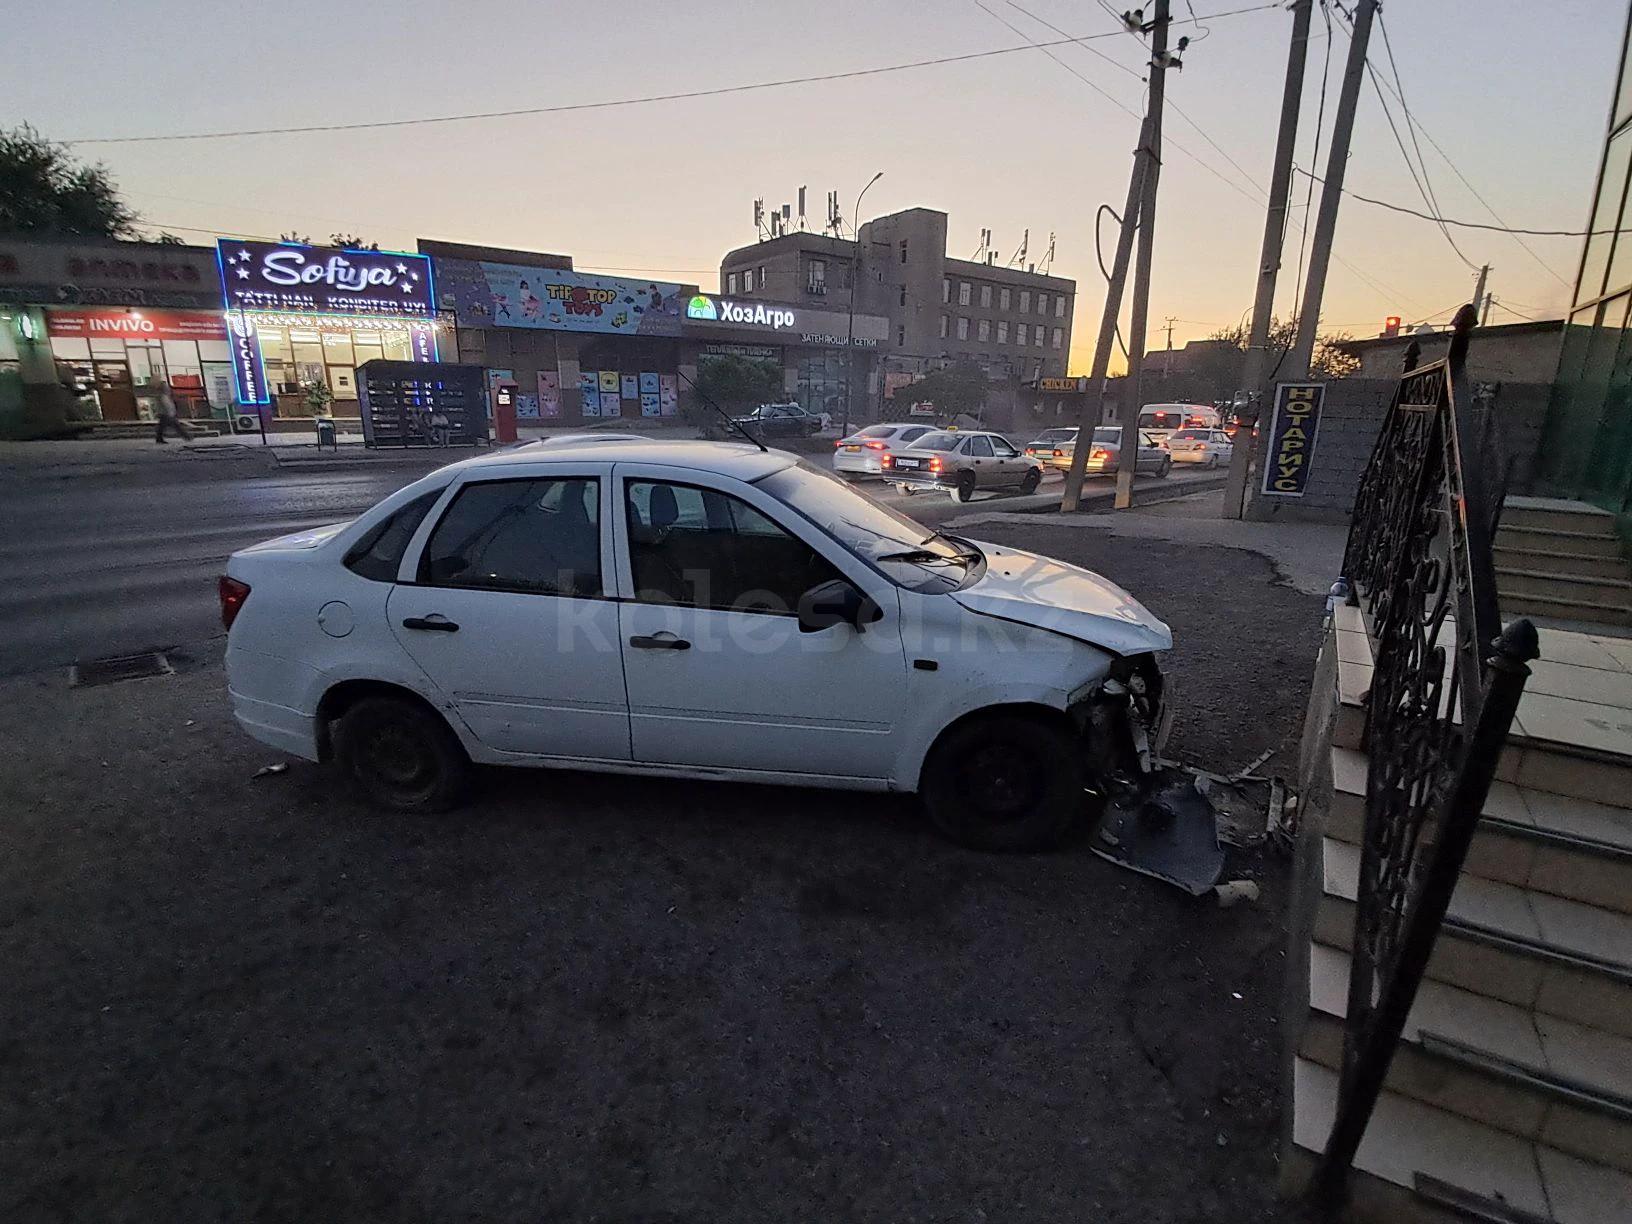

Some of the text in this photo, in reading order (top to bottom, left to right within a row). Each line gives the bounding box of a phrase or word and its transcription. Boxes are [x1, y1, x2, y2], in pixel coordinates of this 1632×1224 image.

[261, 251, 397, 291] Sofiya
[587, 288, 617, 305] TOP
[562, 301, 604, 317] TOYS
[720, 301, 795, 329] ХозАгро
[89, 318, 154, 332] INVIVO
[854, 337, 877, 348] СЕТКИ
[239, 338, 257, 402] COFFEE
[1274, 388, 1314, 491] НОТАРИУС
